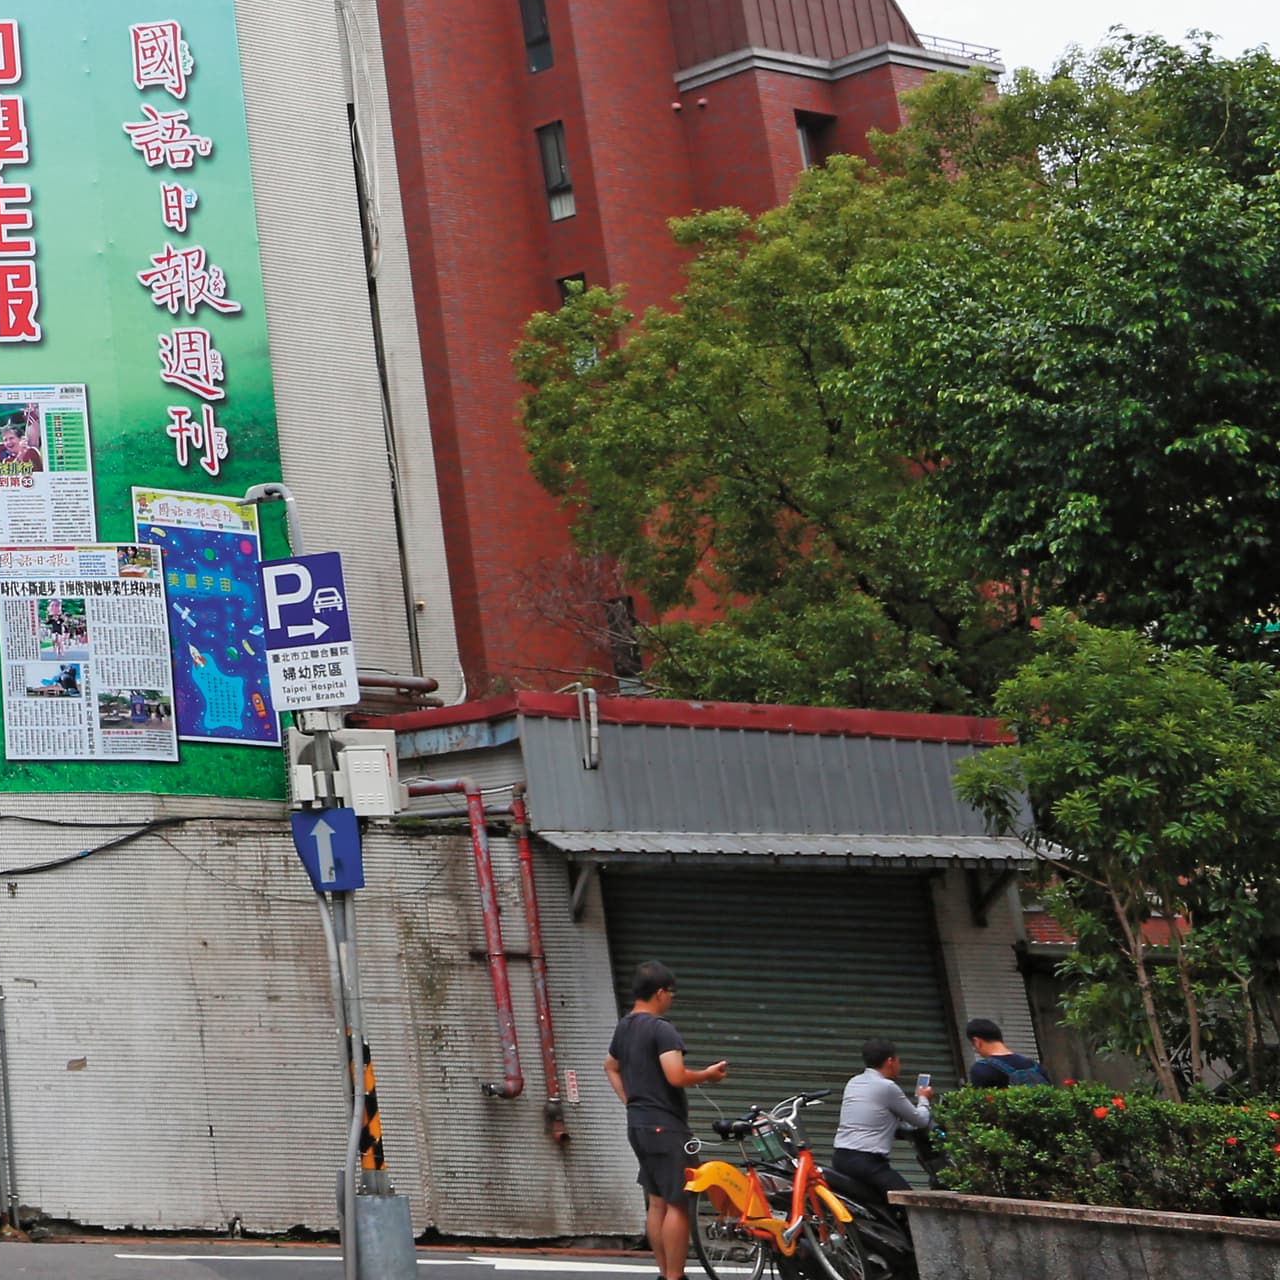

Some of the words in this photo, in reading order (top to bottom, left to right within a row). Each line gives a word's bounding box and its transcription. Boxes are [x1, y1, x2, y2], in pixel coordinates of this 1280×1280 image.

[124, 20, 241, 477] 國語日報週刊
[0, 551, 68, 569] 國語日報
[0, 580, 57, 596] 時代不斷進步
[262, 563, 313, 630] P
[272, 646, 349, 663] 臺北市立聯合醫院
[282, 662, 342, 680] 婦幼院區
[282, 685, 307, 695] Taipei
[311, 679, 347, 692] Hospital
[286, 695, 311, 704] Fuyou
[316, 690, 345, 700] Branch
